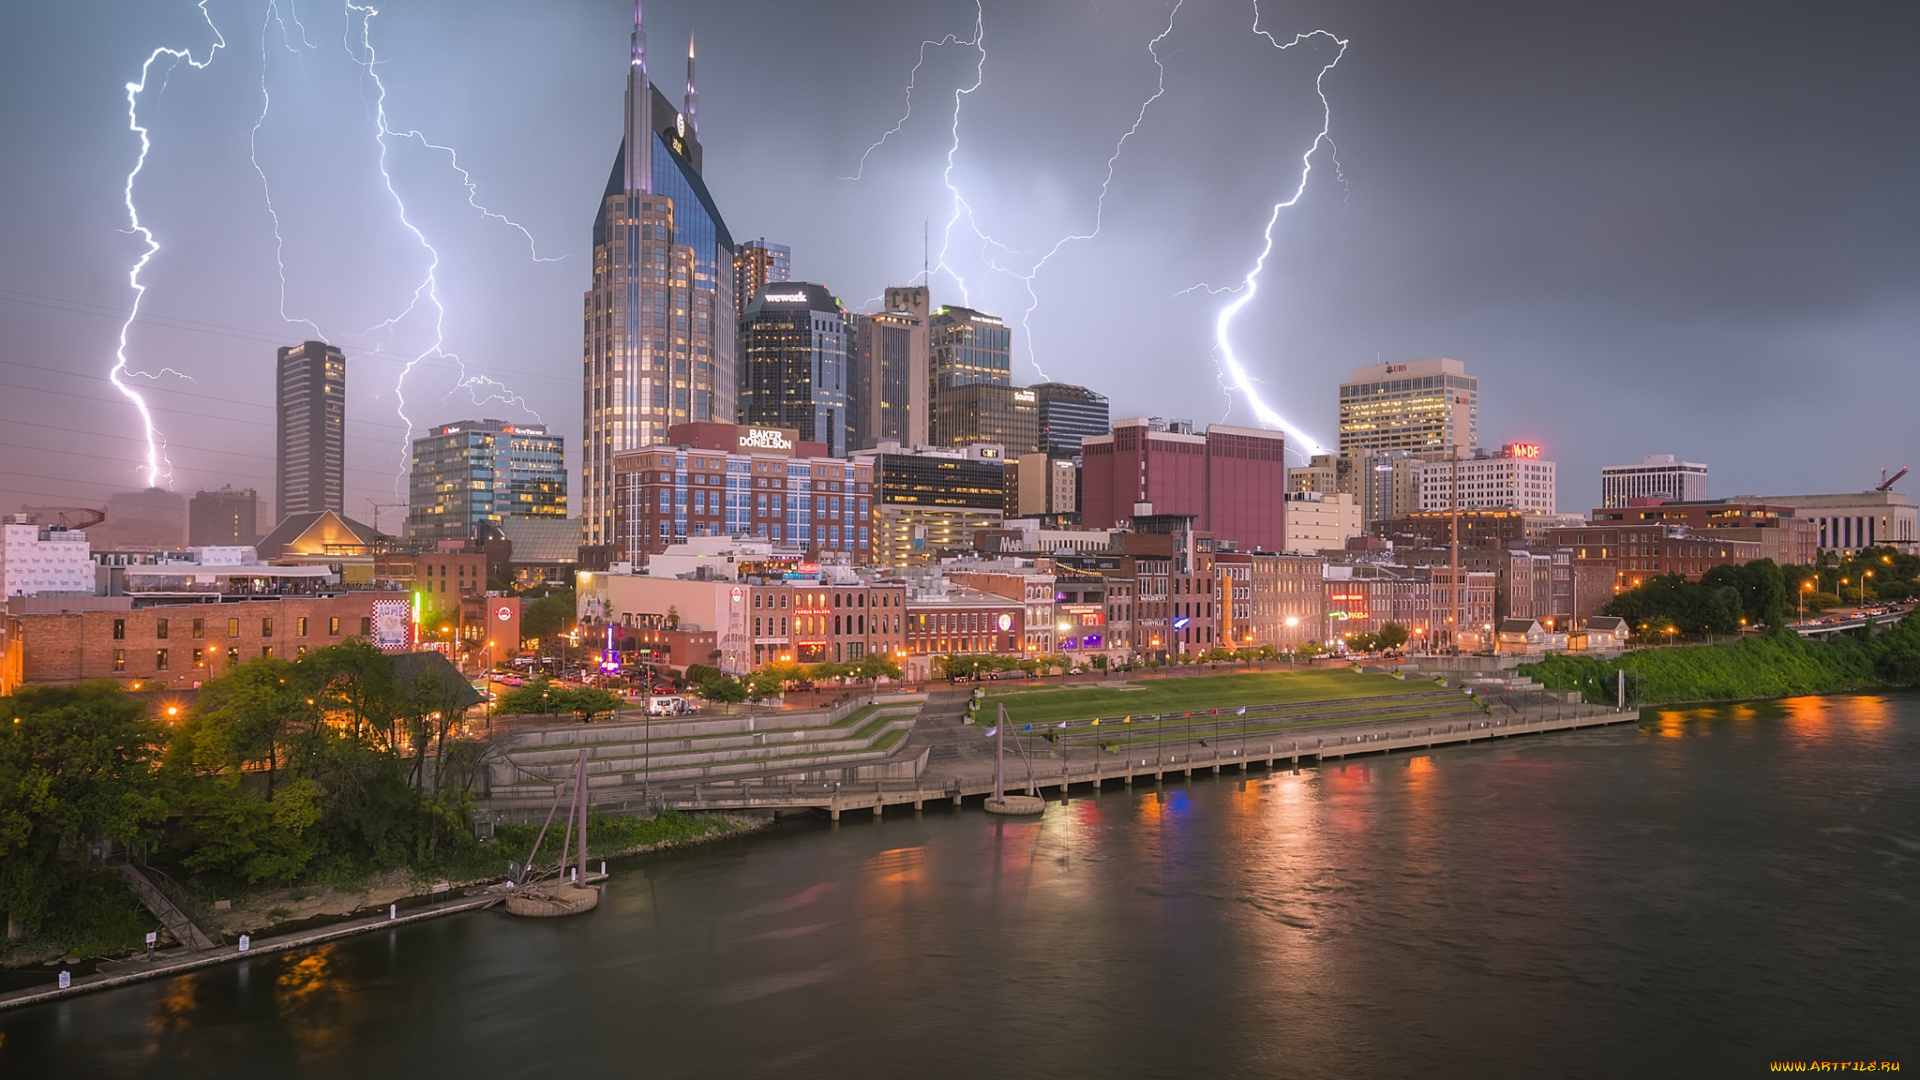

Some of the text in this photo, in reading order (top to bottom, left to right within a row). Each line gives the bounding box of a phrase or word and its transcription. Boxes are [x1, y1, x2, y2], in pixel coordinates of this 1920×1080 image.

[1393, 364, 1407, 373] UBS
[1460, 397, 1470, 405] UBS
[749, 429, 782, 440] BAKER
[739, 436, 792, 449] DONELSON
[982, 449, 997, 458] CMT
